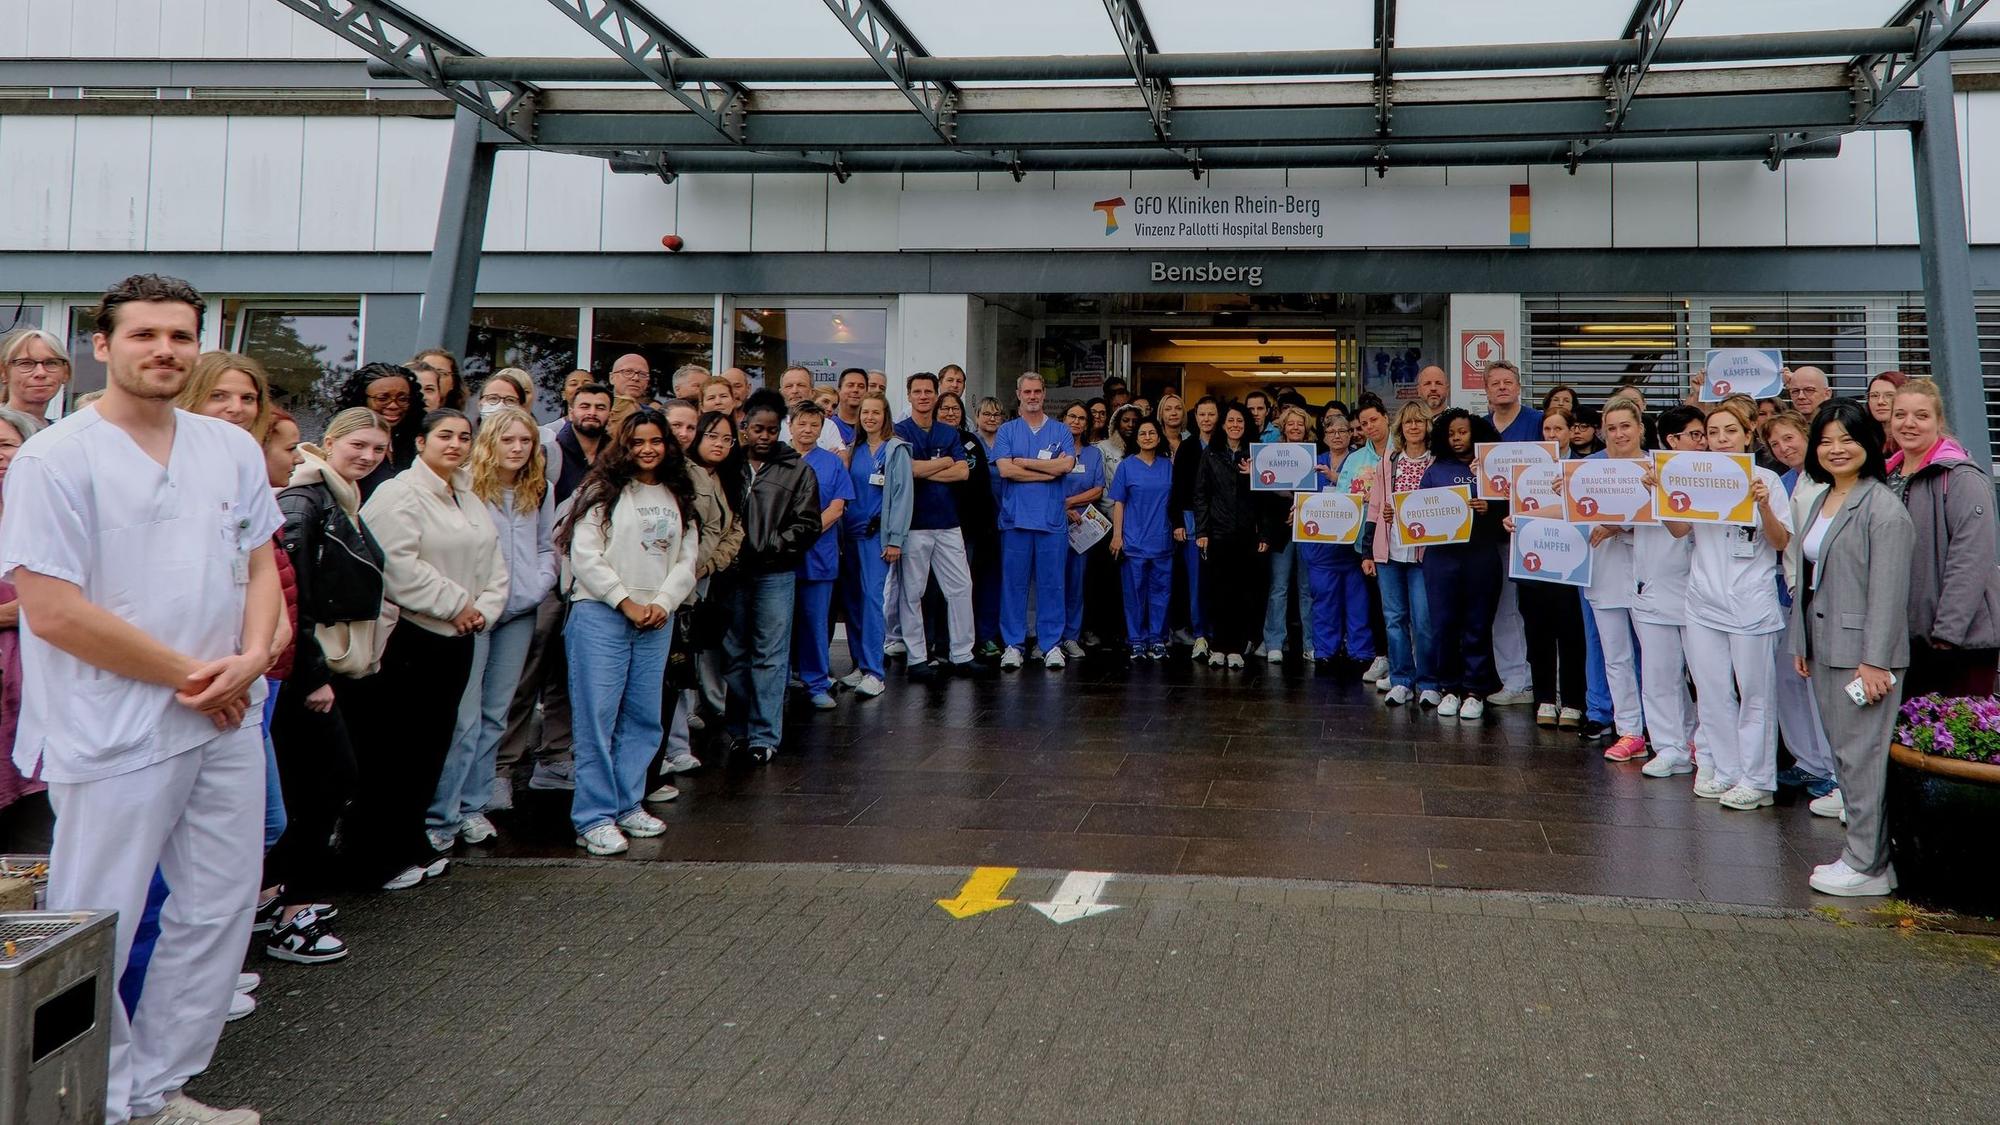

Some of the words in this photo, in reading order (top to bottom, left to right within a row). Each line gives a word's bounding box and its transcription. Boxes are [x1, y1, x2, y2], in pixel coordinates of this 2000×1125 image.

[1134, 196, 1162, 215] GFO
[1167, 195, 1229, 215] Kliniken
[1235, 195, 1321, 218] Rhein-Berg
[1134, 222, 1176, 237] Vinzenz
[1178, 222, 1219, 236] Pallotti
[1222, 221, 1268, 238] Hospital
[1271, 221, 1324, 238] Bensberg
[1150, 261, 1264, 287] Bensberg
[1731, 356, 1749, 365] WIR
[1276, 449, 1290, 457] WIR
[1602, 467, 1617, 475] WIR
[1692, 462, 1713, 473] WIR
[1581, 477, 1616, 485] BRAUCHEN
[1617, 477, 1640, 485] UNSER
[1668, 475, 1739, 490] PROTESTIEREN
[1585, 487, 1636, 495] KRANKENHAUS!
[1322, 500, 1337, 508] WIR
[1423, 496, 1440, 505] WIR
[1305, 510, 1353, 520] PROTESTIEREN
[1406, 506, 1461, 519] PROTESTIEREN
[1543, 527, 1560, 537] WIR
[1533, 540, 1571, 553] KÄMPFEN
